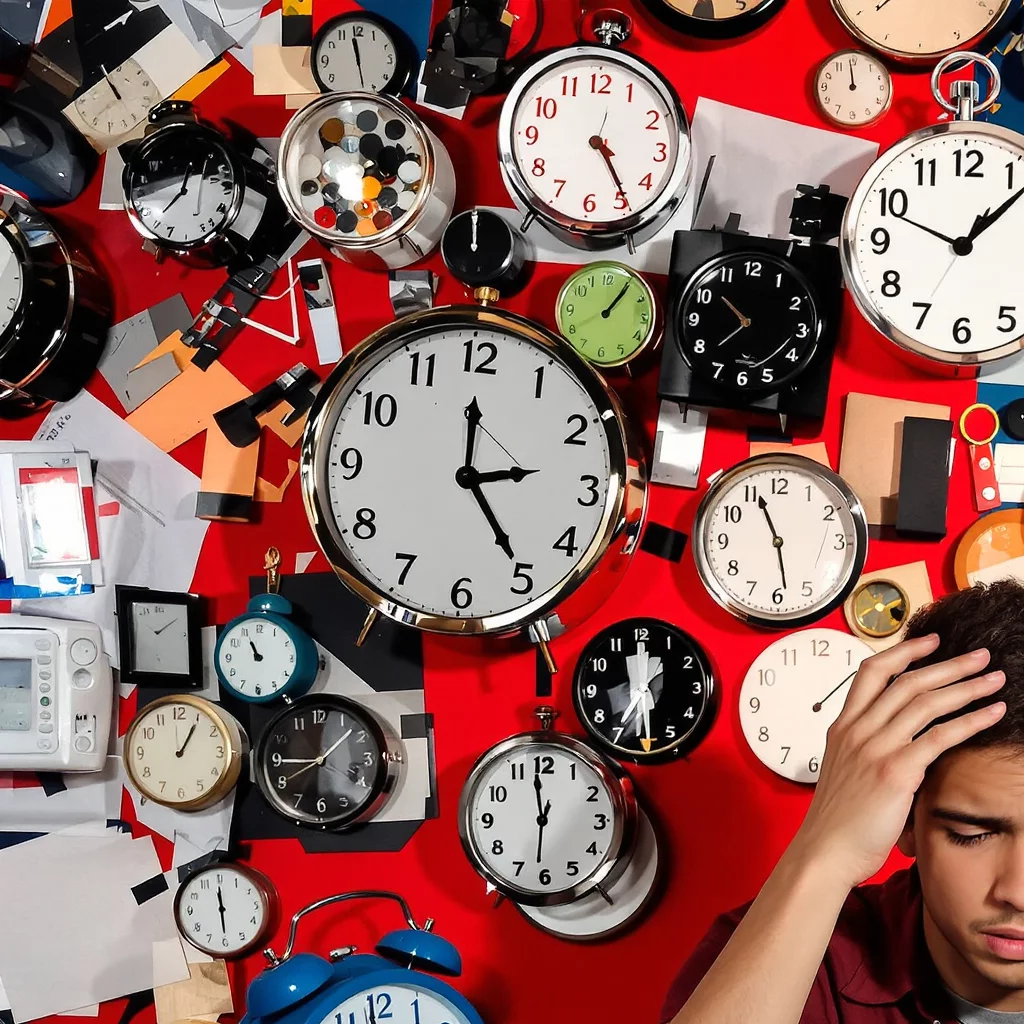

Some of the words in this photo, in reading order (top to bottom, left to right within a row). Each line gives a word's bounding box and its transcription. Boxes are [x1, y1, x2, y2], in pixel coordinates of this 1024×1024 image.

[562, 76, 577, 96] 11
[591, 74, 611, 94] 12
[627, 83, 632, 102] 1
[536, 97, 557, 119] 10
[646, 110, 659, 130] 2
[526, 126, 538, 145] 9
[653, 143, 666, 162] 3
[532, 158, 545, 176] 8
[915, 158, 936, 186] 11
[953, 149, 984, 177] 12
[638, 173, 652, 190] 4
[1005, 162, 1013, 189] 1
[554, 179, 566, 198] 7
[583, 194, 596, 212] 6
[612, 191, 627, 209] 5
[879, 188, 908, 218] 10
[871, 228, 890, 255] 9
[745, 262, 761, 276] 12
[881, 270, 901, 297] 8
[697, 288, 711, 303] 10
[789, 297, 801, 310] 2
[689, 313, 699, 326] 9
[913, 302, 932, 329] 7
[997, 306, 1016, 332] 5
[953, 318, 971, 344] 6
[694, 339, 705, 353] 8
[464, 340, 497, 375] 12
[410, 352, 435, 386] 11
[534, 366, 544, 398] 1
[363, 391, 397, 427] 10
[564, 414, 587, 445] 2
[341, 448, 362, 480] 9
[578, 475, 599, 506] 3
[772, 478, 788, 494] 12
[353, 508, 376, 539] 8
[724, 506, 741, 523] 10
[553, 526, 578, 557] 4
[718, 533, 728, 549] 9
[396, 553, 417, 585] 7
[510, 562, 533, 594] 5
[451, 578, 472, 609] 6
[772, 588, 783, 604] 6
[593, 658, 606, 671] 10
[683, 656, 692, 668] 2
[666, 726, 675, 738] 5
[534, 756, 554, 774] 12
[489, 786, 507, 802] 10
[586, 786, 598, 802] 2
[482, 813, 493, 829] 9
[539, 869, 551, 885] 6
[567, 861, 578, 876] 5
